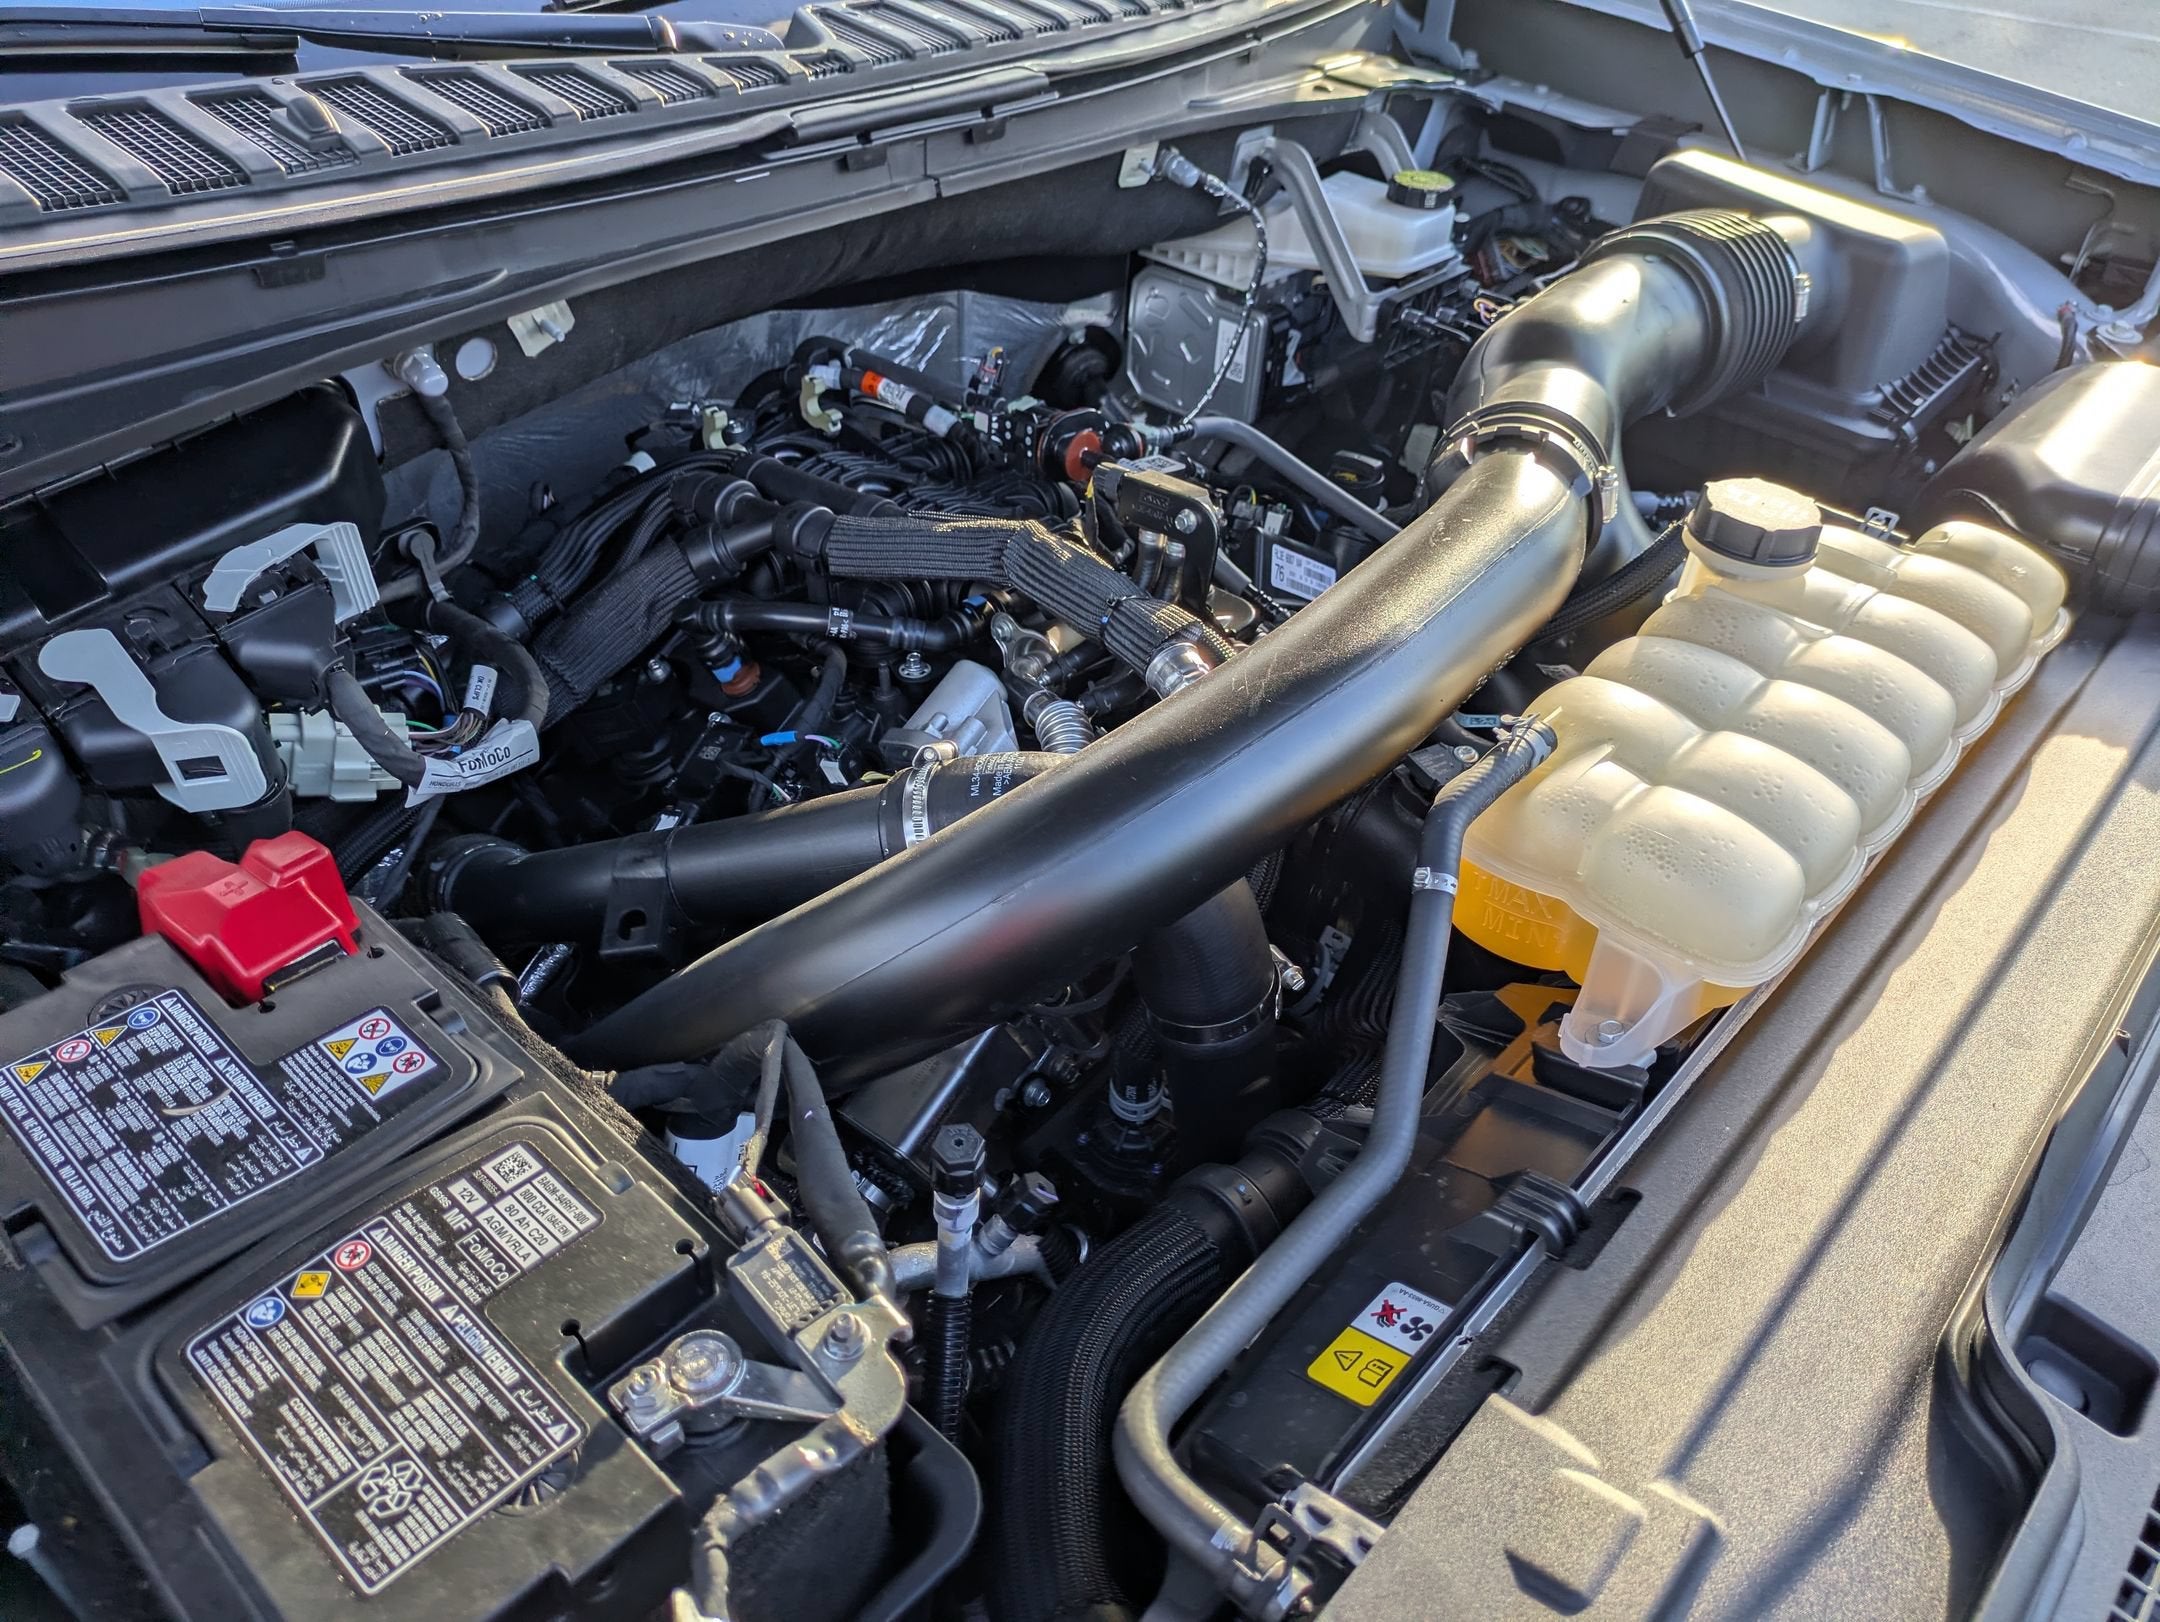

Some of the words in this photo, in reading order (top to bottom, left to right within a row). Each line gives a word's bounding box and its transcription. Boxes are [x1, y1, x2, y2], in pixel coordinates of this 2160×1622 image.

[1275, 563, 1284, 582] 76
[993, 771, 1003, 796] Made
[1487, 876, 1555, 919] MAX
[1481, 907, 1545, 949] MIN
[166, 1002, 220, 1055] DANGER/POISON
[220, 1062, 277, 1119] PELIGRO/VENENO
[20, 1117, 38, 1130] NE
[27, 1125, 46, 1142] PAS
[36, 1137, 66, 1169] OUVRIR.
[456, 1186, 478, 1205] 12V
[518, 1188, 536, 1203] 800
[531, 1200, 550, 1217] CCA
[544, 1211, 572, 1237] (SAE/EN)
[536, 1175, 590, 1225] BAGM-94RH7-800
[441, 1206, 474, 1235] MF
[482, 1213, 532, 1262] AGM/VRLA
[503, 1203, 520, 1218] 80
[514, 1214, 532, 1230] Ah
[527, 1227, 549, 1247] C20
[378, 1234, 445, 1303] DANGER/POISON
[461, 1233, 513, 1283] FoMoCo
[206, 1340, 233, 1369] Batterie
[219, 1331, 240, 1352] Lead
[232, 1348, 252, 1367] Acid
[242, 1362, 271, 1393] Battery
[225, 1365, 238, 1378] au
[231, 1324, 281, 1382] NON-SPILLABLE
[448, 1312, 522, 1388] PELIGRO/VENENO
[194, 1348, 214, 1370] ANTI
[207, 1364, 255, 1420] DÉVERSEMENT
[231, 1373, 257, 1401] plomb
[288, 1396, 318, 1430] CONTRA
[311, 1426, 352, 1473] DERRAMES
[382, 1477, 401, 1495] Pb
